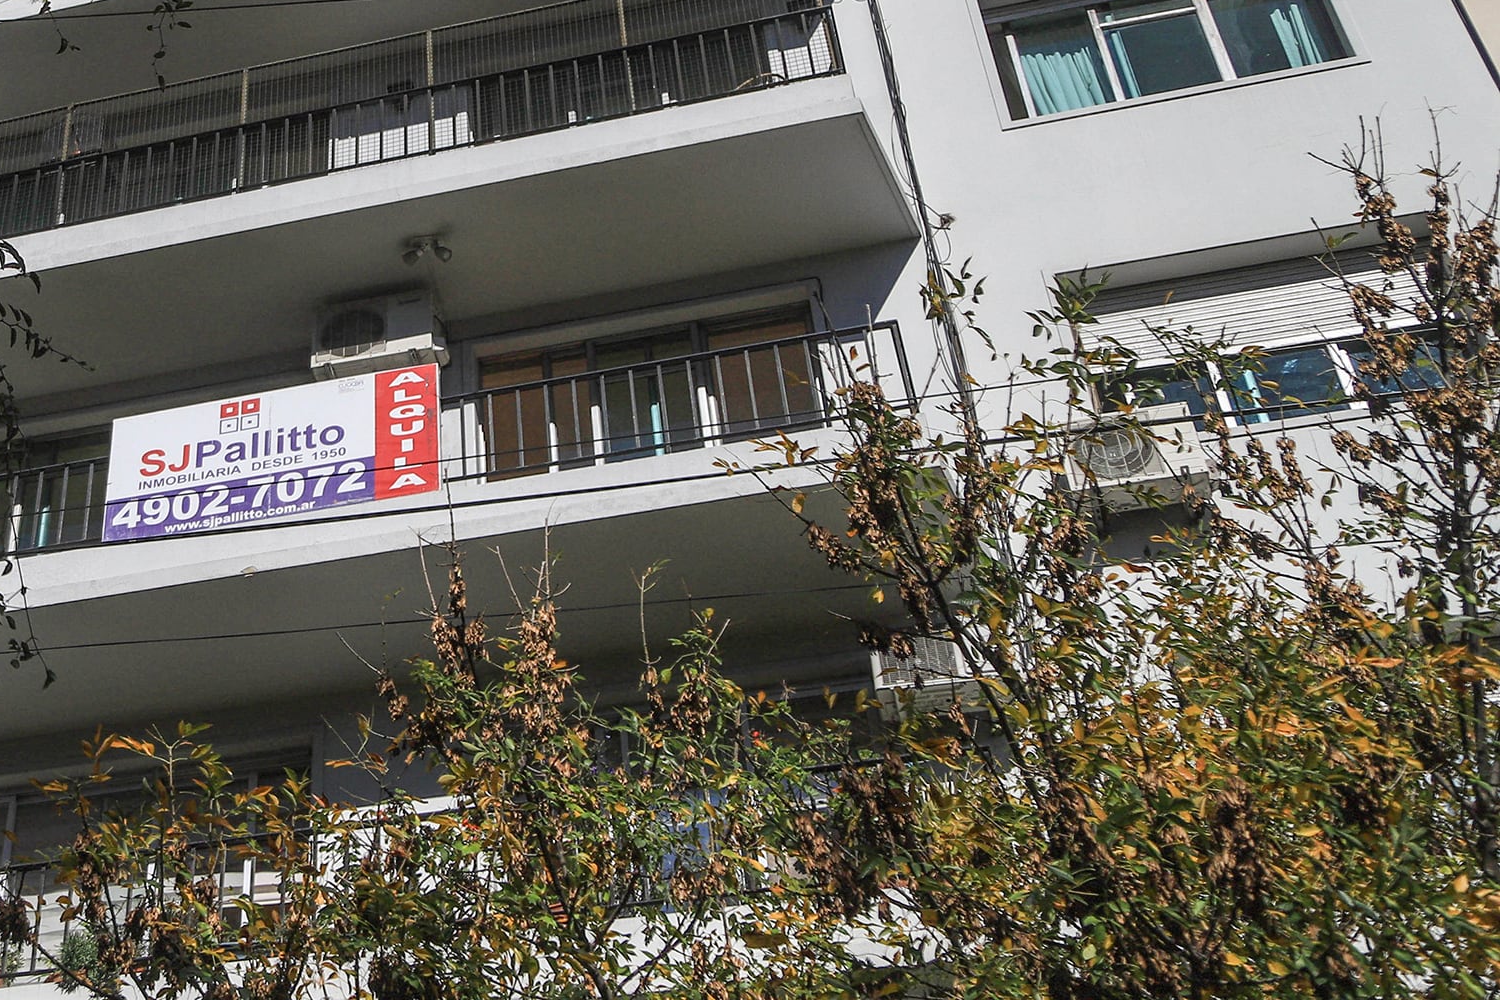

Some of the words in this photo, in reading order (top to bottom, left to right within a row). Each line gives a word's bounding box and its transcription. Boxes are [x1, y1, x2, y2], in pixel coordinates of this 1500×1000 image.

[139, 424, 345, 477] SJPallitto
[388, 371, 428, 490] ALQUILA
[138, 465, 241, 490] INMOBILIARIA
[251, 454, 304, 472] DESDE
[312, 446, 347, 461] 1950
[112, 461, 367, 529] 4902-7072
[164, 501, 316, 534] www.sjpallitto.com.ar
